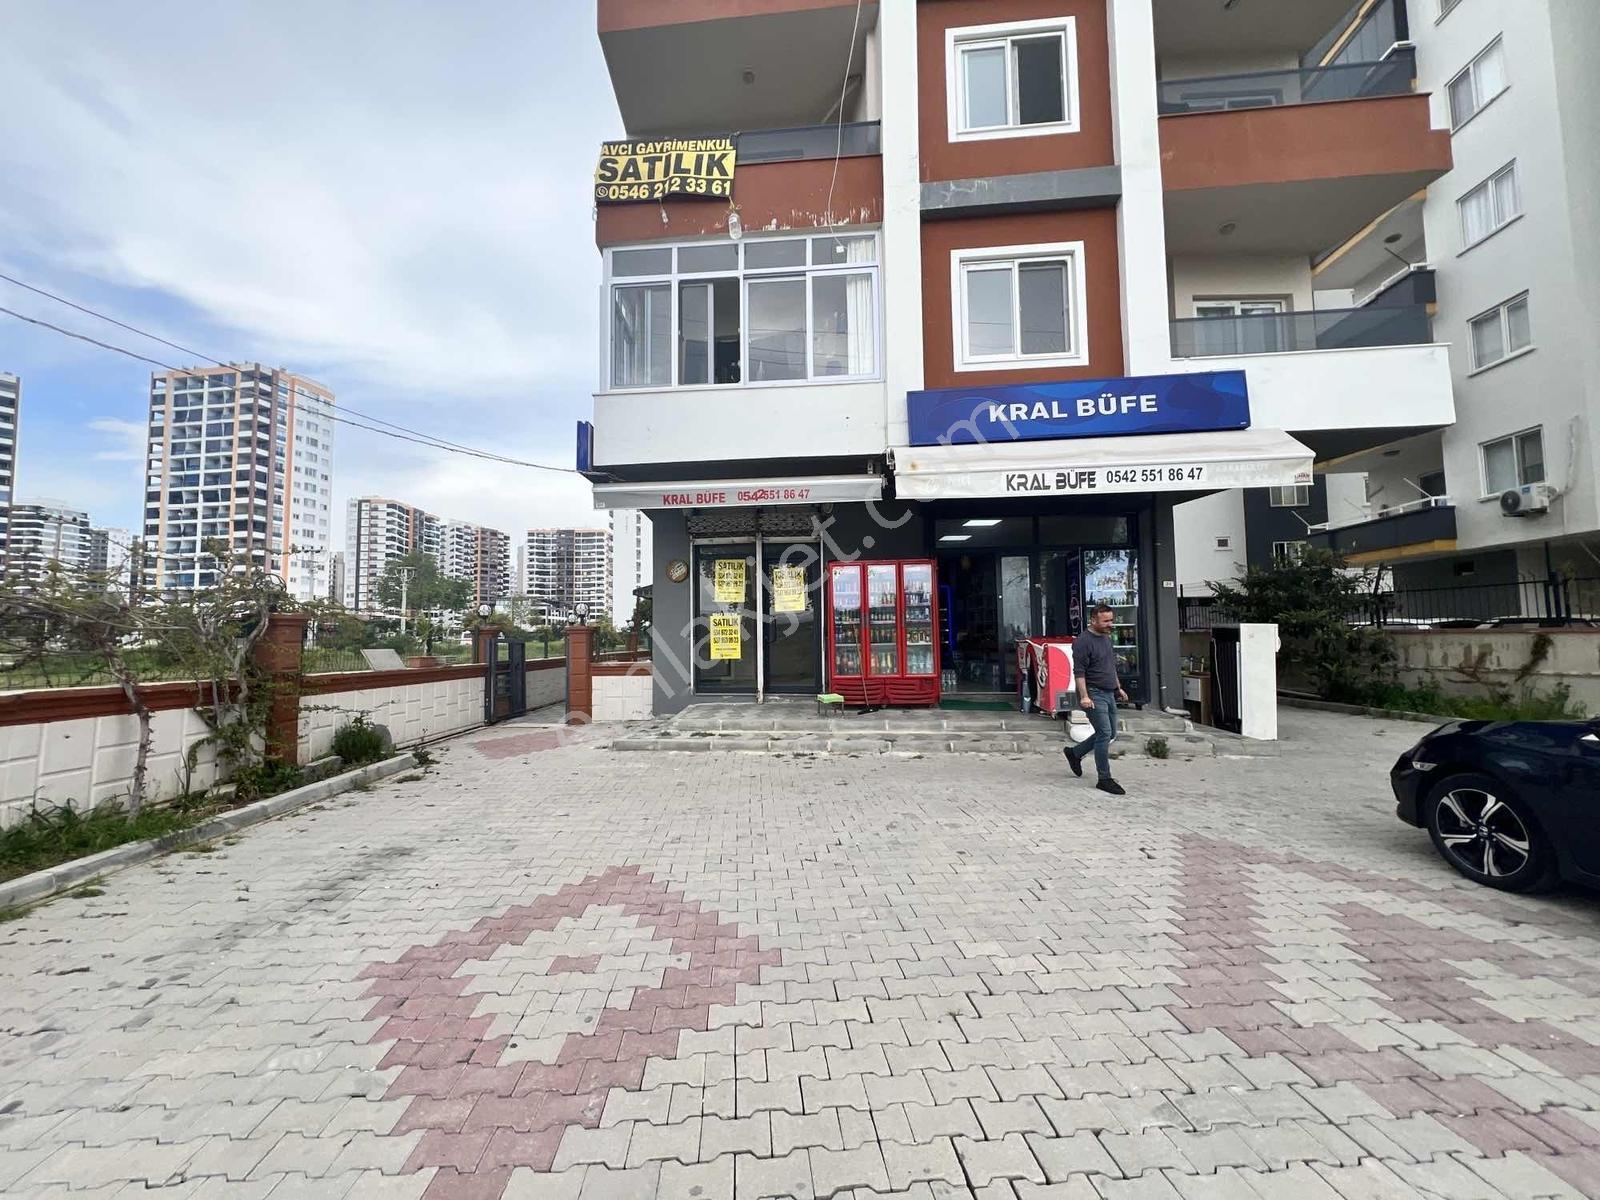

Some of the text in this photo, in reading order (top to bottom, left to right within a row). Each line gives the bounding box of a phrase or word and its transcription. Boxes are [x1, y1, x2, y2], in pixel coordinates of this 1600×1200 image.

[601, 139, 733, 156] AVCI GAYRİMENKUL
[598, 153, 729, 183] SATILIK
[608, 177, 731, 199] 0546 212 33 61
[989, 393, 1158, 423] KRAL BÜFE
[1005, 466, 1203, 492] KRAL BÜFE 0542 551 86 47
[662, 493, 693, 505] KRAL
[696, 491, 726, 504] BÜFE
[783, 489, 796, 499] 86
[798, 488, 810, 499] 47
[713, 618, 739, 627] SATILIK
